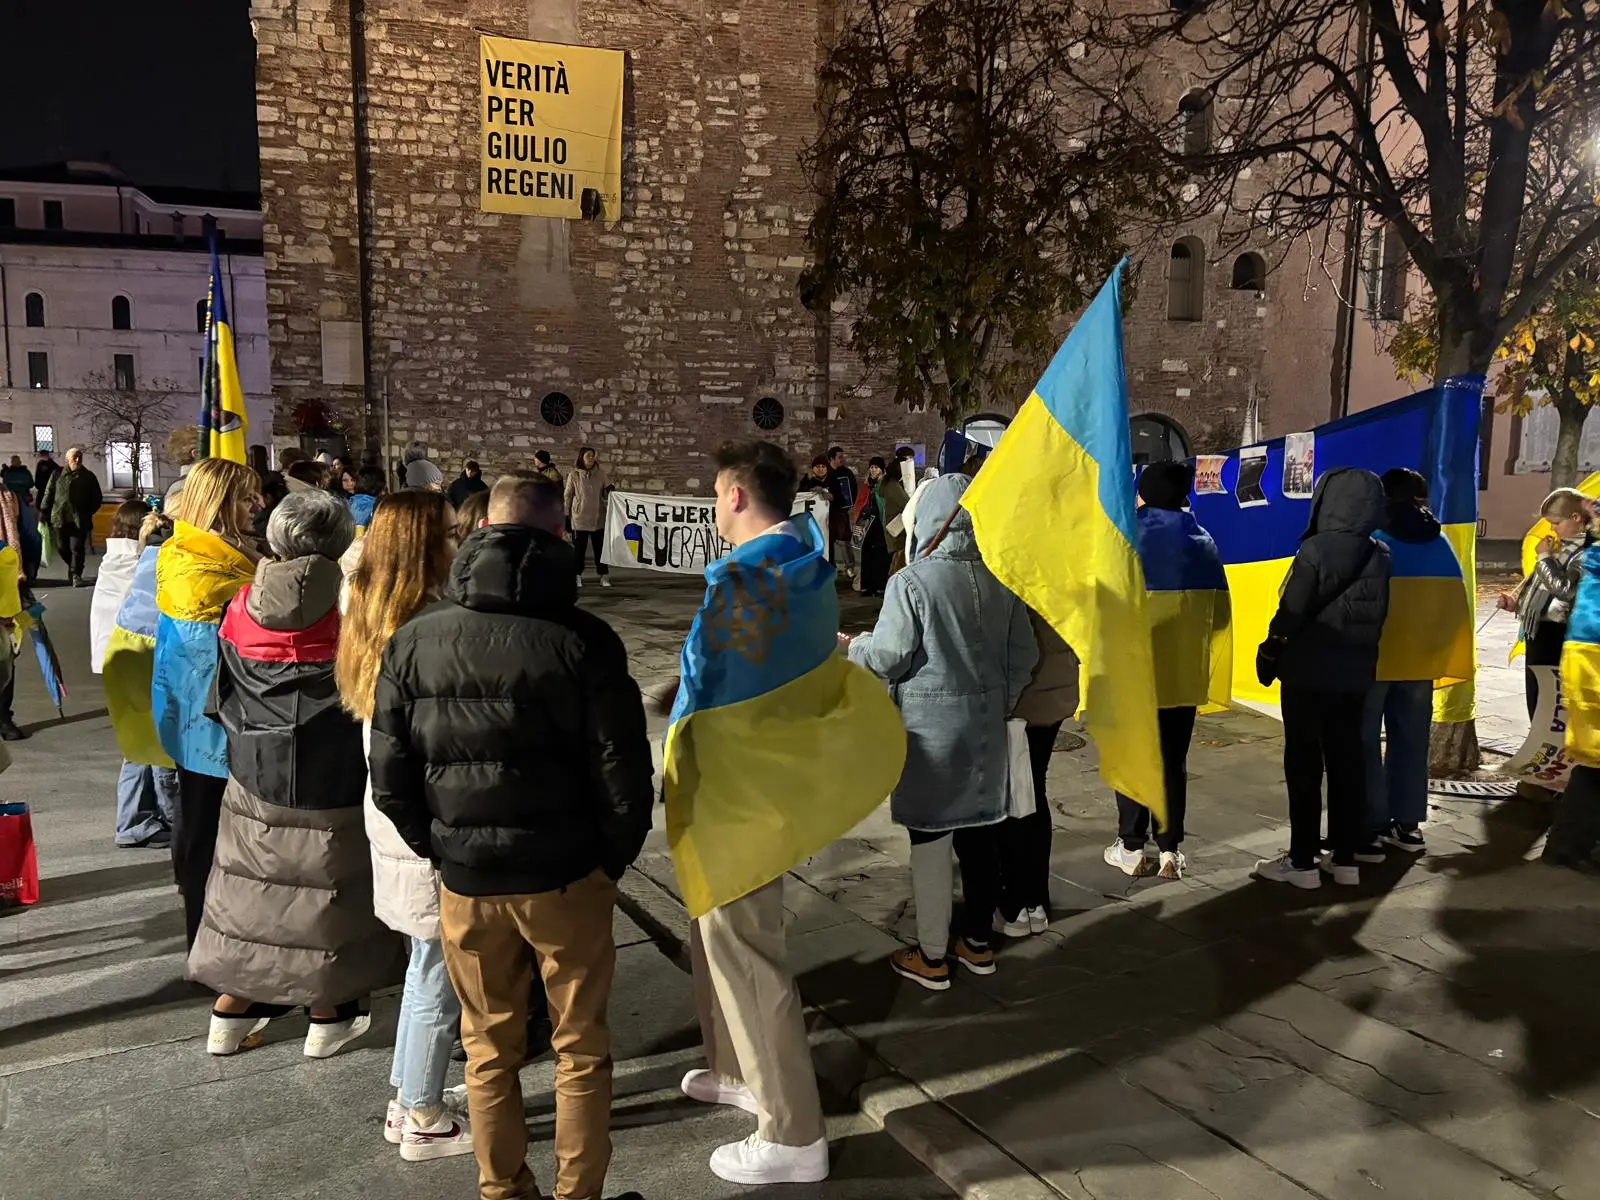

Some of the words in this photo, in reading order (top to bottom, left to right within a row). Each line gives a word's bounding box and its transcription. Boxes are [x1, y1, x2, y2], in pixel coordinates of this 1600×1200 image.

[486, 59, 569, 95] VERITÀ
[487, 96, 535, 127] PER
[487, 131, 567, 165] GIULIO
[487, 167, 574, 200] REGENI
[625, 499, 649, 521] LA
